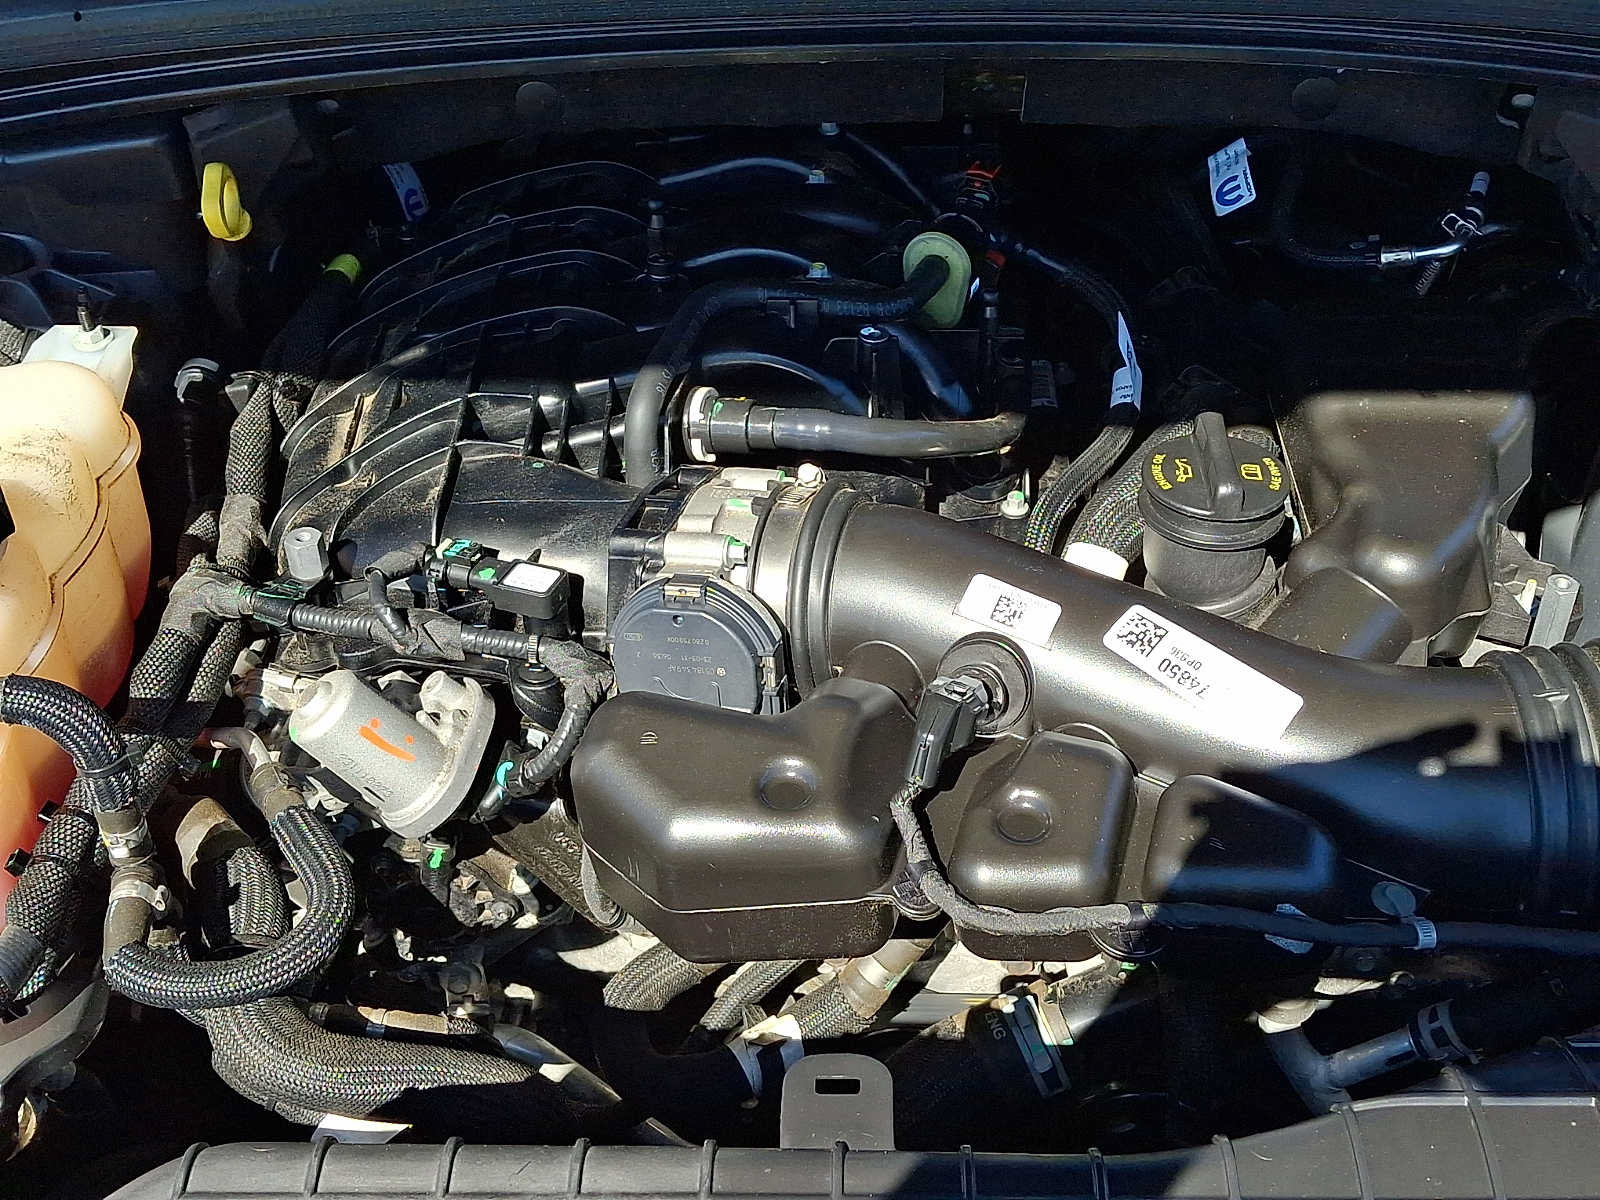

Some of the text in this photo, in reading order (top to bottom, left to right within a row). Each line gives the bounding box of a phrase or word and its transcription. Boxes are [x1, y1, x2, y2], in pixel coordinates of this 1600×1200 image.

[1151, 453, 1173, 490] ENGINE OIL
[1158, 658, 1210, 700] 74850
